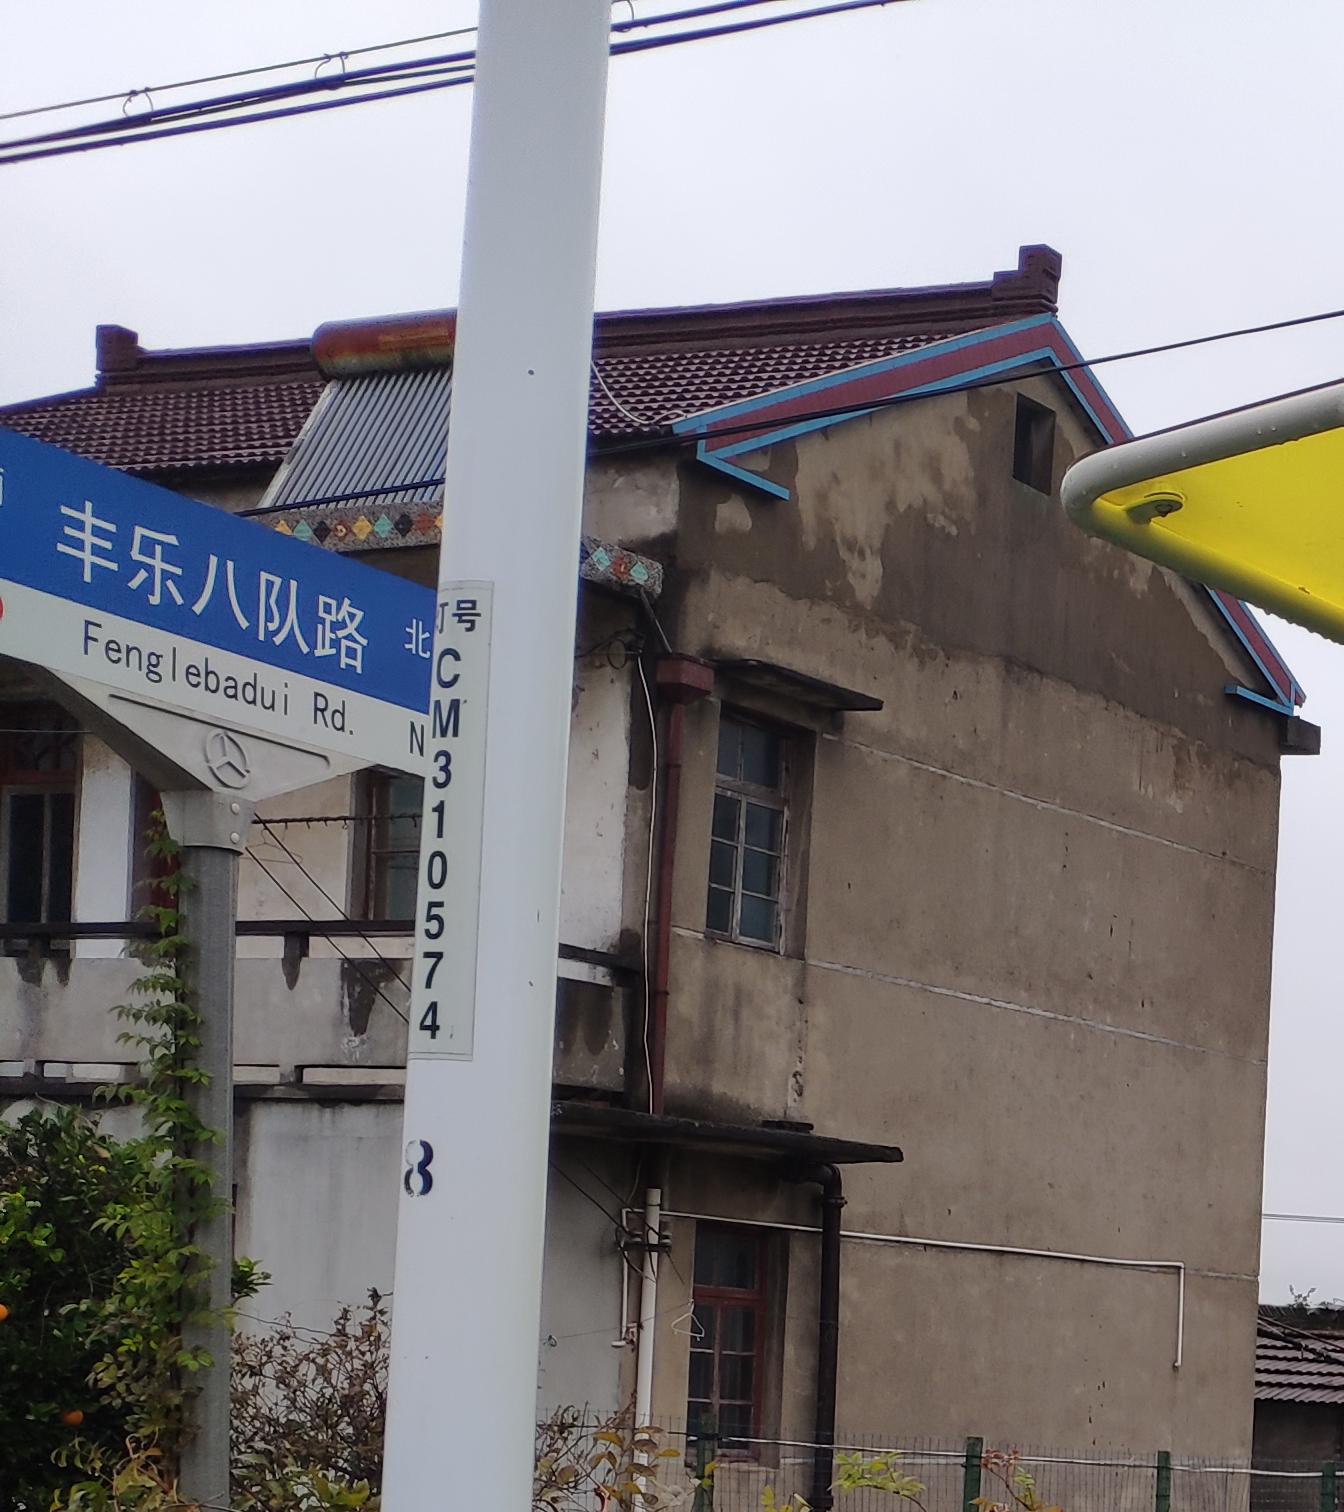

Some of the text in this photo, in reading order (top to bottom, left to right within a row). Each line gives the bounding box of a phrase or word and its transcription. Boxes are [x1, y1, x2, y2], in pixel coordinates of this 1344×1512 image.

[56, 499, 431, 675] 丰乐八队路 北
[82, 618, 425, 758] Fenglebadui Rd. N
[404, 1138, 434, 1198] 8
